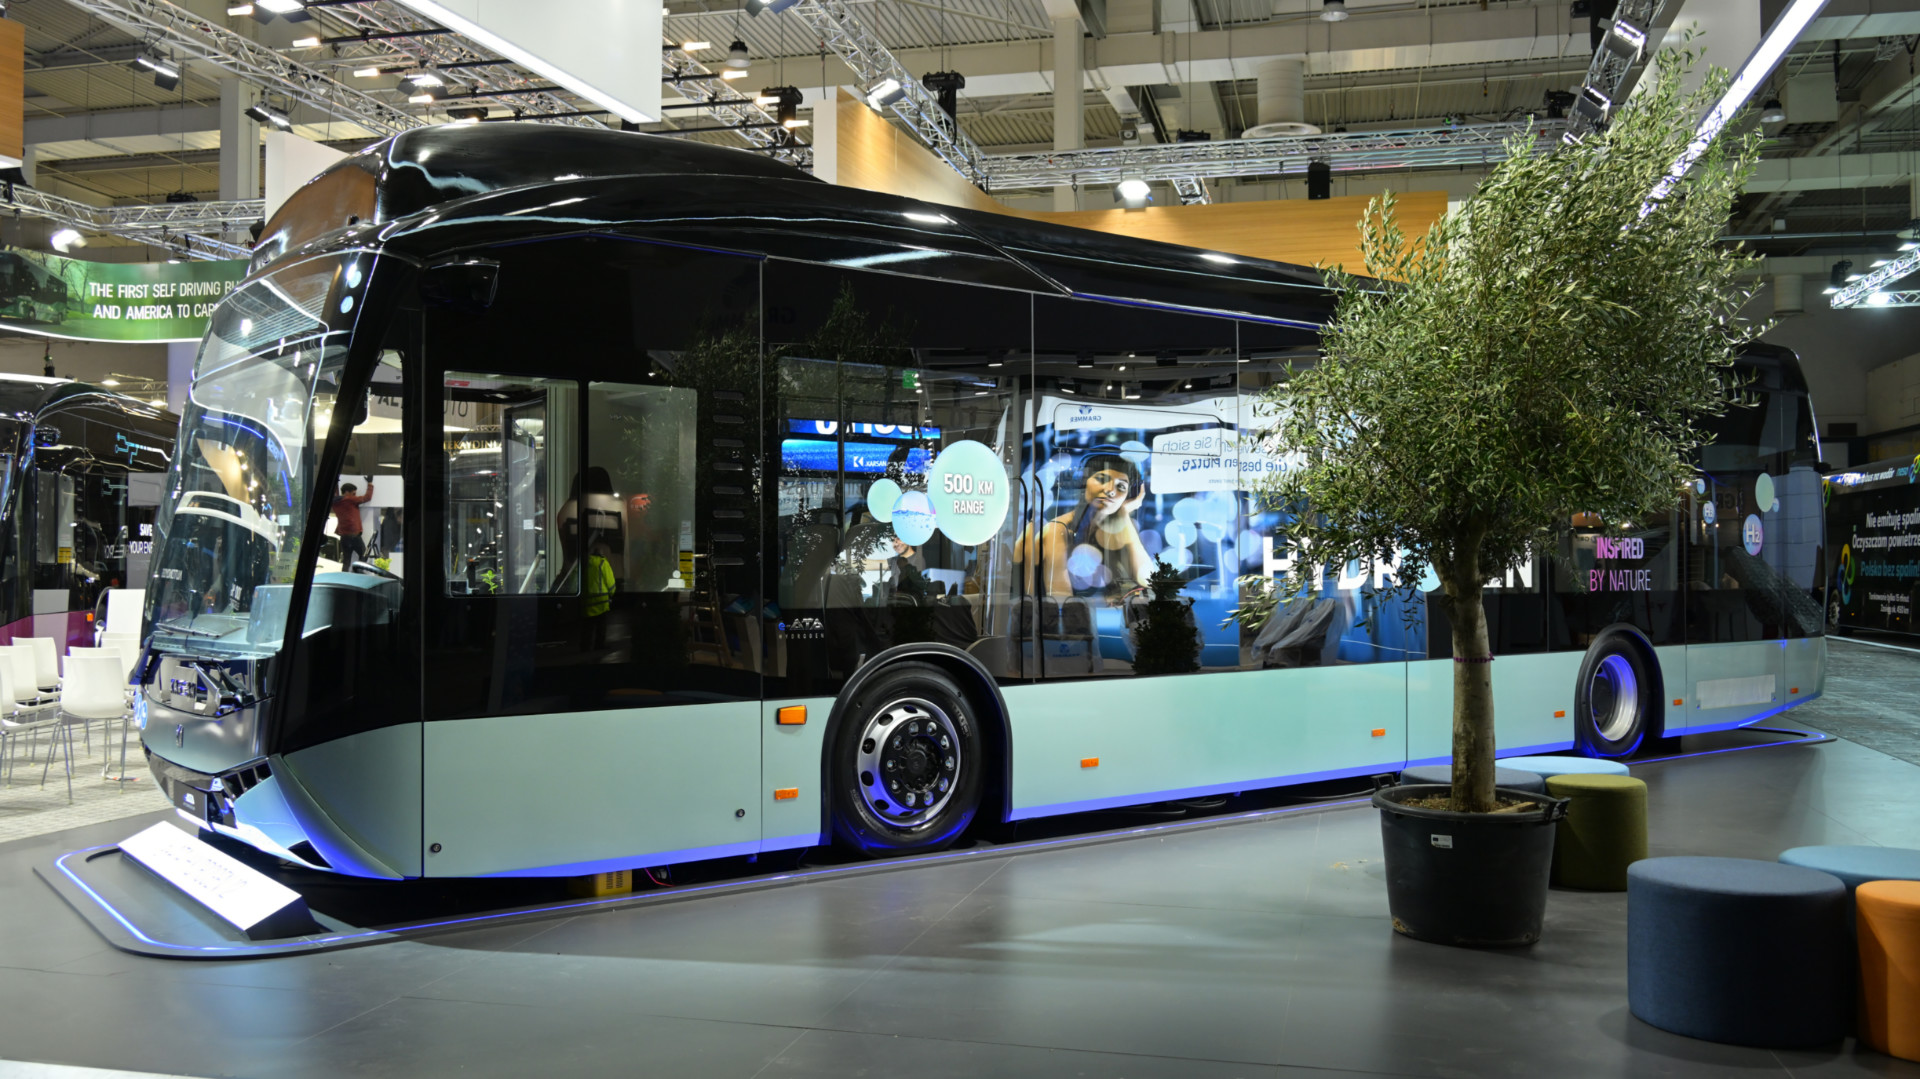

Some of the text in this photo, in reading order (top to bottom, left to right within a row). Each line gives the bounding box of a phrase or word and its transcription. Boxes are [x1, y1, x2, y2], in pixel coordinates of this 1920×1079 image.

[89, 282, 114, 298] THE
[118, 284, 149, 299] FIRST
[152, 283, 176, 298] SELF
[180, 281, 221, 296] DRIVING
[93, 304, 121, 319] AND
[126, 304, 173, 320] AMERICA
[176, 303, 190, 318] TO
[943, 473, 993, 495] 500 KM
[953, 500, 985, 514] RANGE
[1745, 523, 1761, 543] H2
[1596, 537, 1644, 559] INSPIRED
[1589, 569, 1652, 592] BY NATURE
